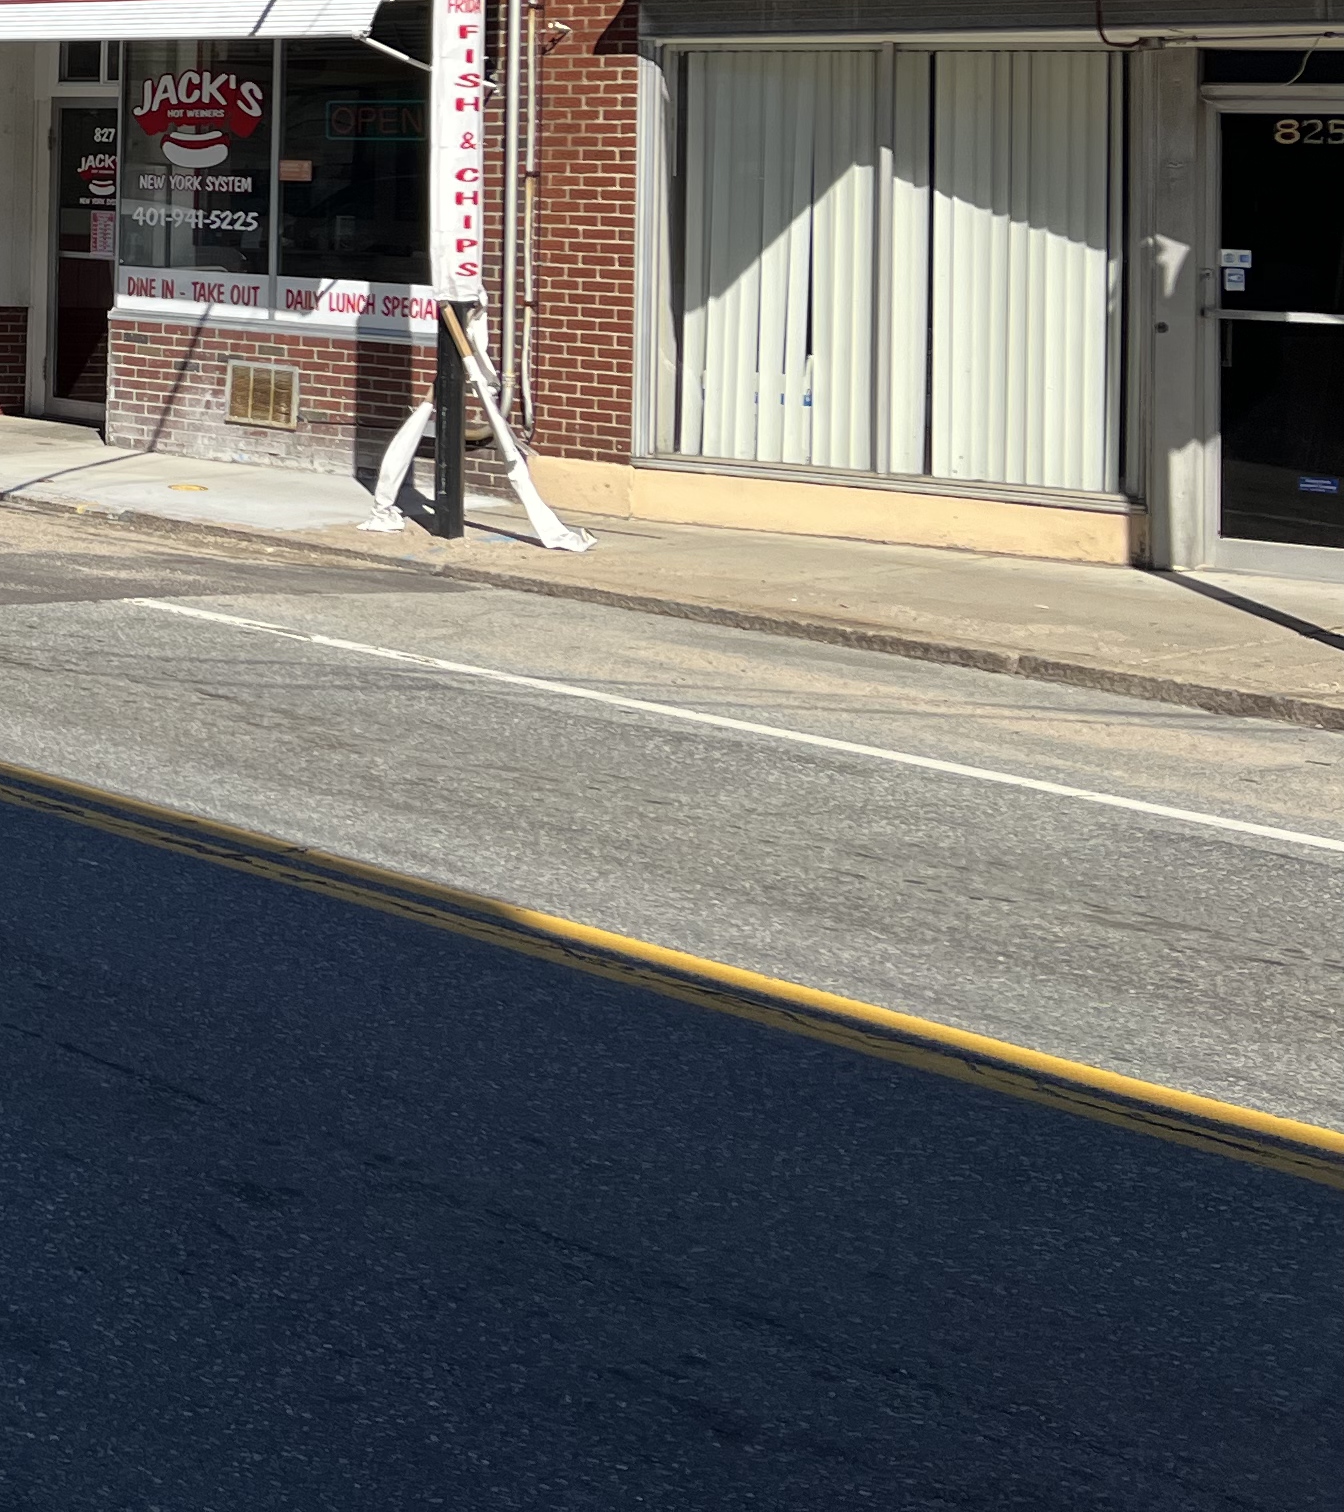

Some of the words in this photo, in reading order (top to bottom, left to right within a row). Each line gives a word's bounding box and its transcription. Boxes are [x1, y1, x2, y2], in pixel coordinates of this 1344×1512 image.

[132, 69, 263, 117] JACK'S
[167, 109, 184, 118] HOT
[187, 109, 225, 118] WEINERS
[331, 107, 425, 134] OPEN
[94, 127, 115, 142] 827
[459, 131, 477, 150] &
[139, 175, 165, 189] NEW
[169, 175, 202, 191] YORK
[205, 176, 252, 193] SYSTEM
[132, 206, 259, 231] 401-941-5225
[127, 276, 156, 298] DINE
[162, 279, 175, 299] IN
[192, 281, 224, 304] TAKE
[230, 285, 260, 307] OUT
[286, 288, 322, 311] DAILY
[329, 292, 376, 315] LUNCH
